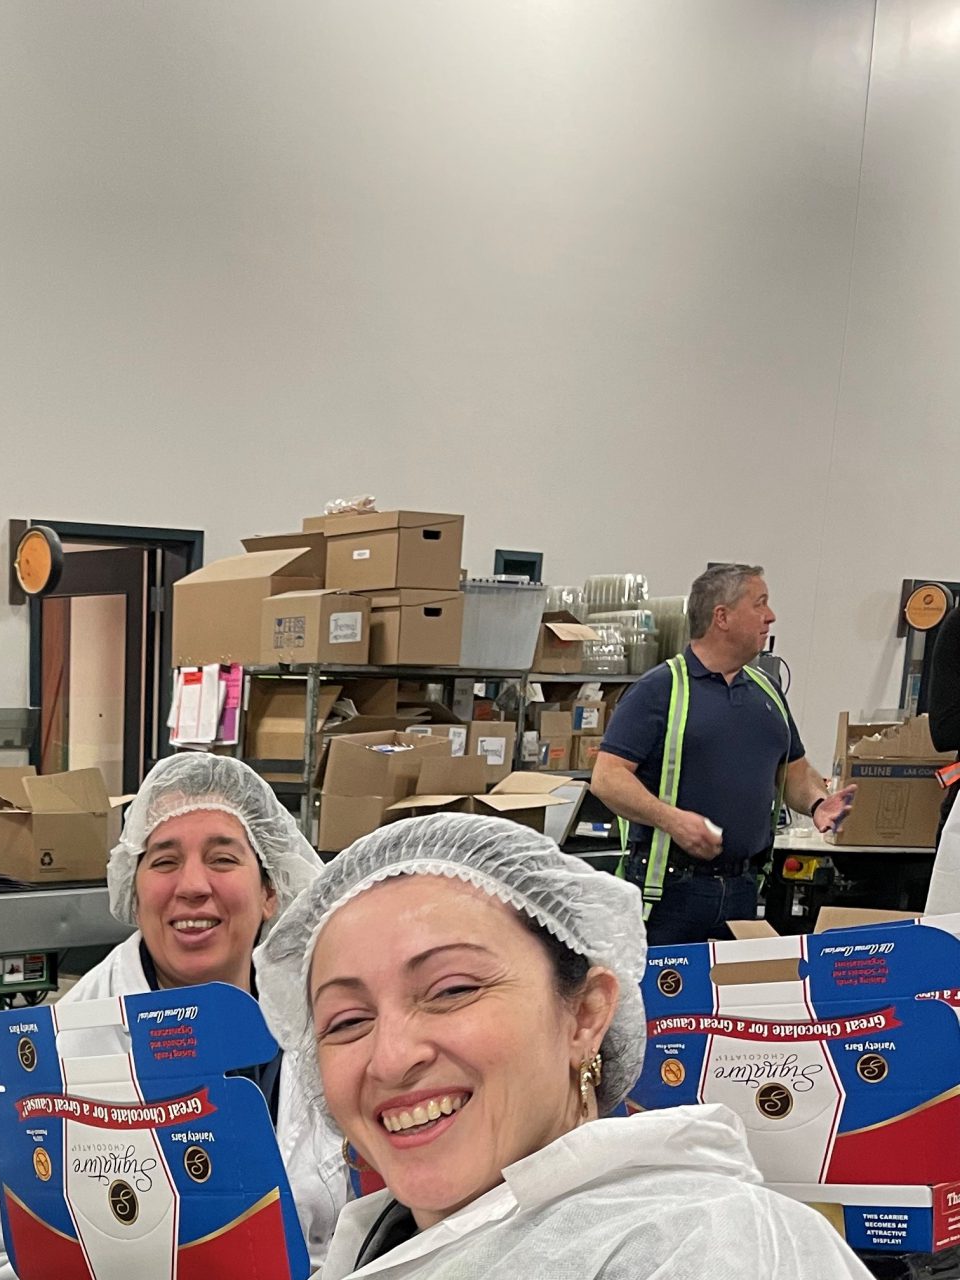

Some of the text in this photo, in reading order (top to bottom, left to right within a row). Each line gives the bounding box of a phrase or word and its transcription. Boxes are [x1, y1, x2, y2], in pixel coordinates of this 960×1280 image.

[860, 767, 892, 776] ULINE
[664, 957, 689, 966] Variety
[20, 1023, 39, 1033] Variety
[700, 1018, 733, 1032] Great
[737, 1021, 745, 1031] a
[845, 1014, 886, 1029] Great
[748, 1022, 768, 1037] for
[772, 1023, 840, 1037] Chocolate
[845, 1042, 896, 1051] Variety Bars
[713, 1054, 823, 1092] Signature
[55, 1098, 80, 1116] Great
[83, 1103, 90, 1115] a
[93, 1106, 109, 1122] for
[168, 1098, 202, 1119] Great
[111, 1107, 166, 1124] Chocolate
[171, 1130, 215, 1143] Variety Bars
[72, 1145, 157, 1192] Signature
